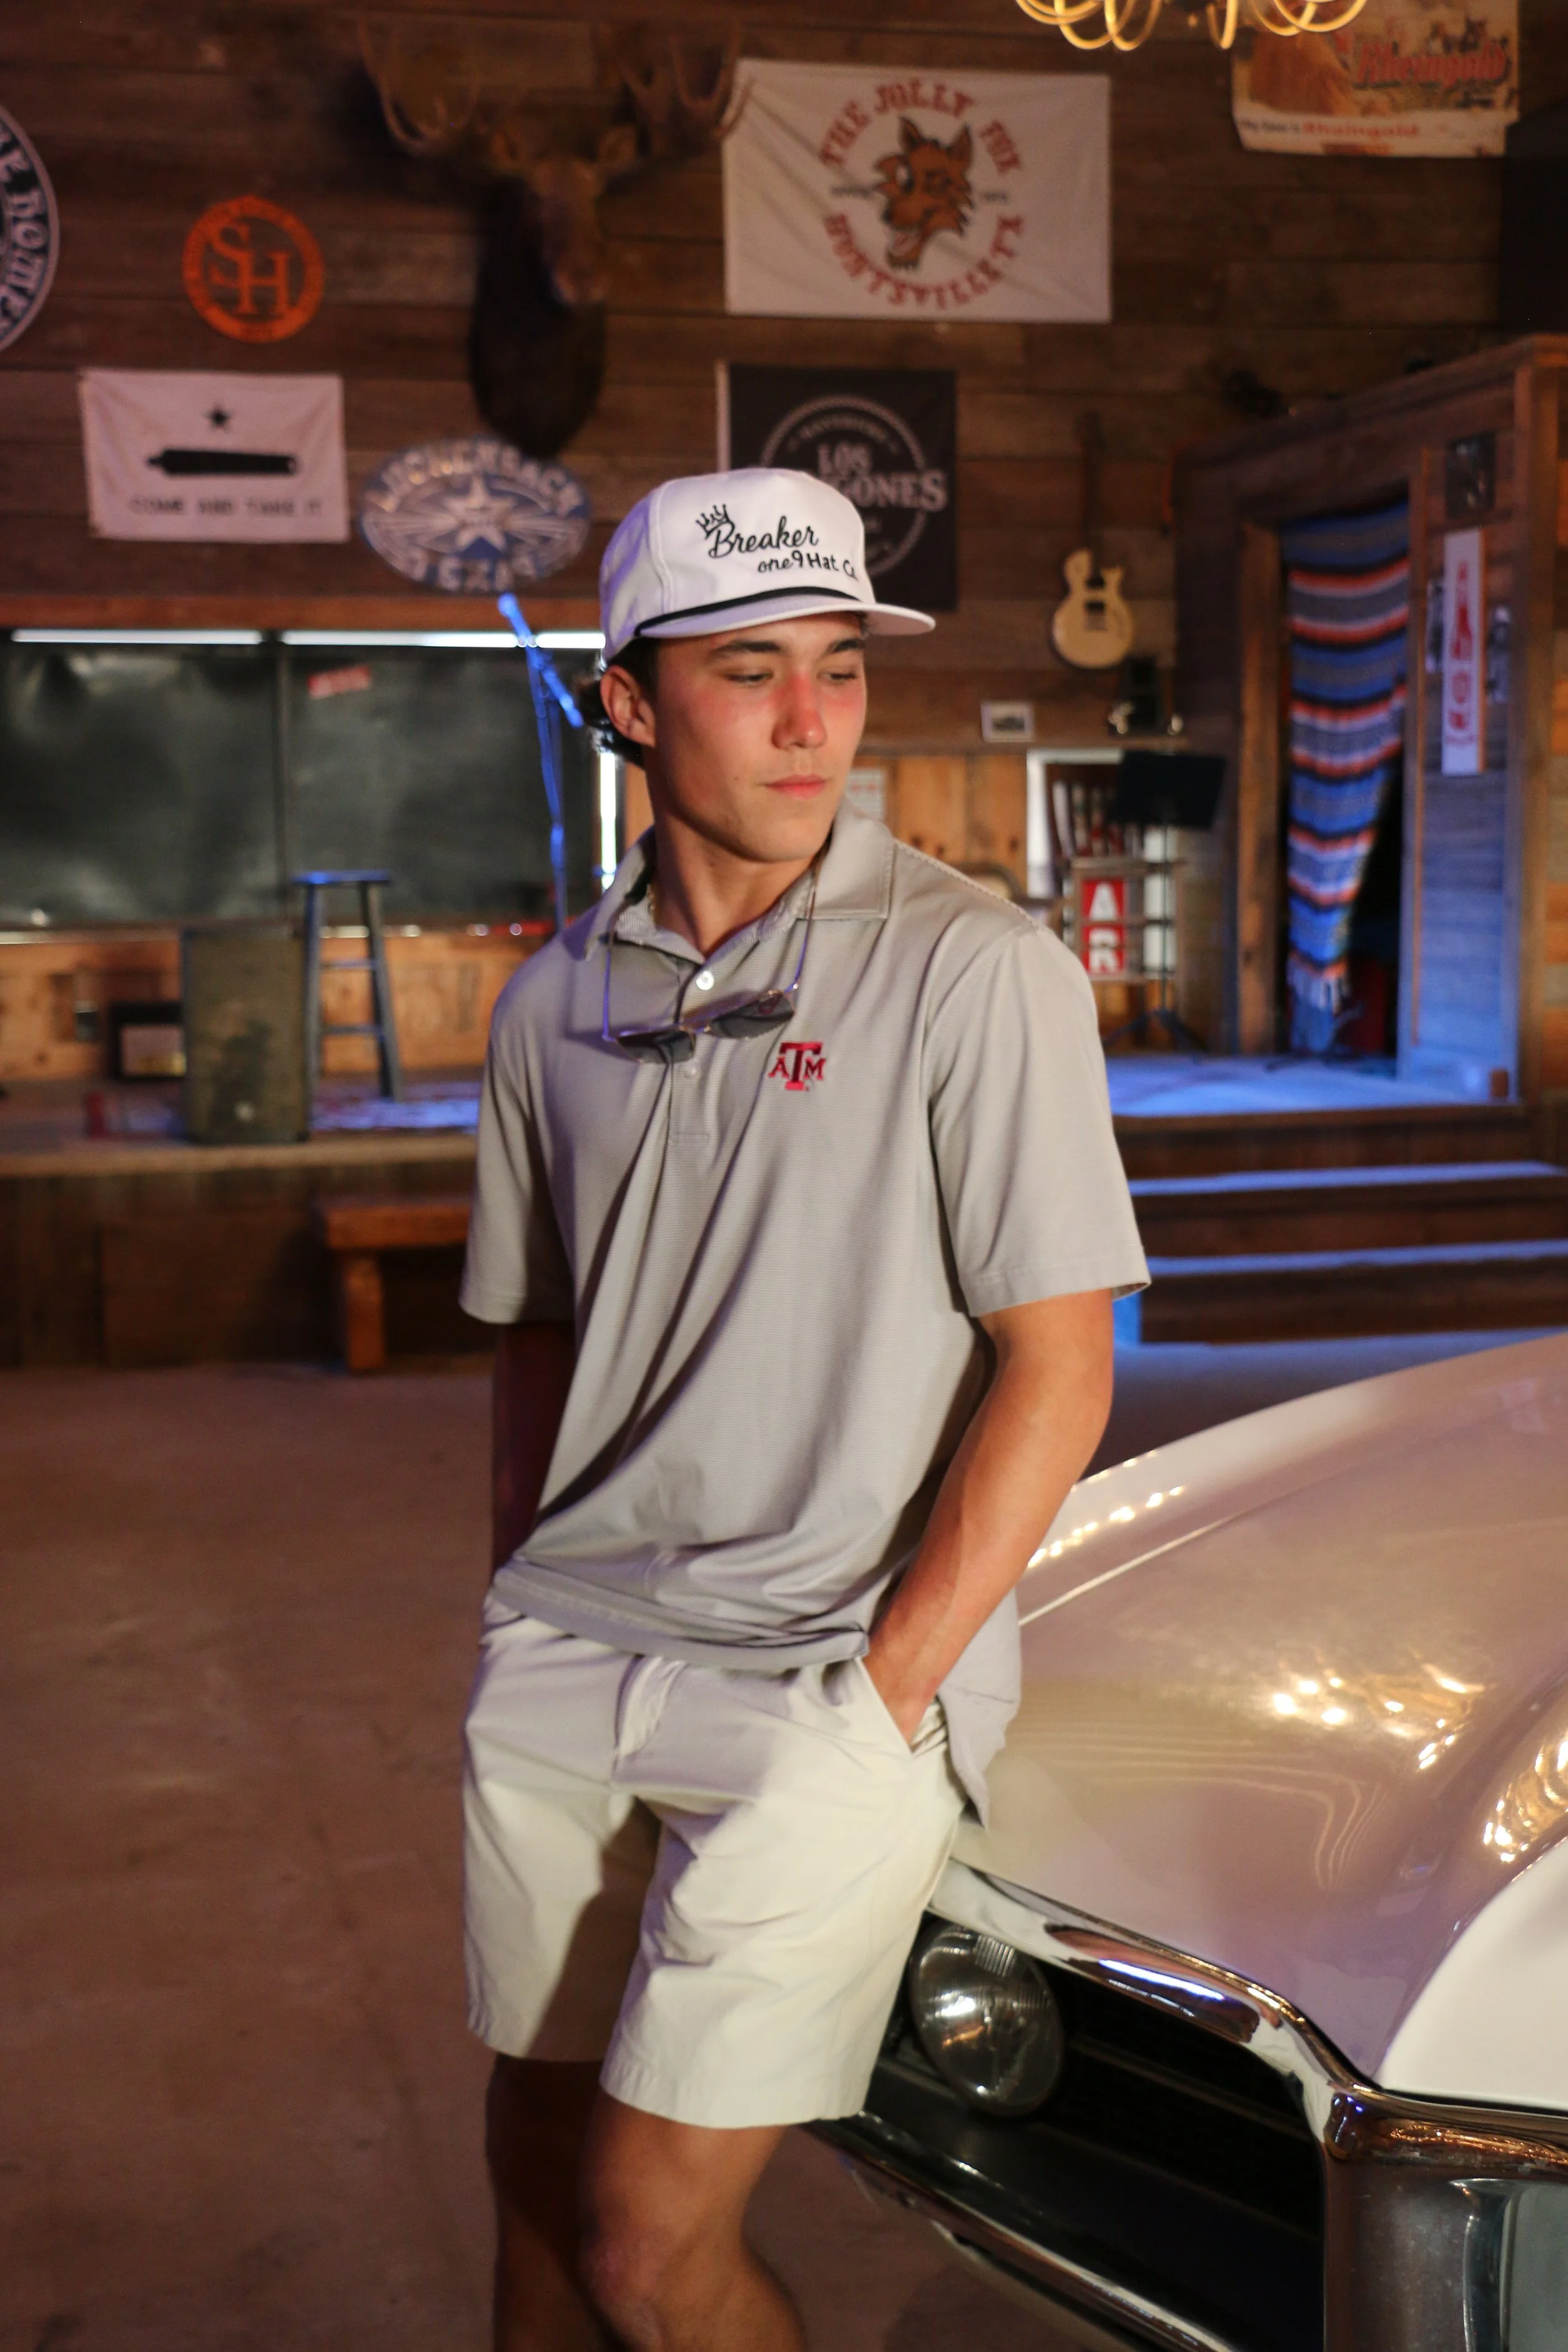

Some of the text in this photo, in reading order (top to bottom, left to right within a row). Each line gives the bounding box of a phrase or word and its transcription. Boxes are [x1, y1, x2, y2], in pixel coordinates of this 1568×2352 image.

[819, 100, 871, 167] THE
[874, 78, 975, 118] JOLLY
[707, 514, 819, 558] Breaker
[806, 553, 839, 571] Hat
